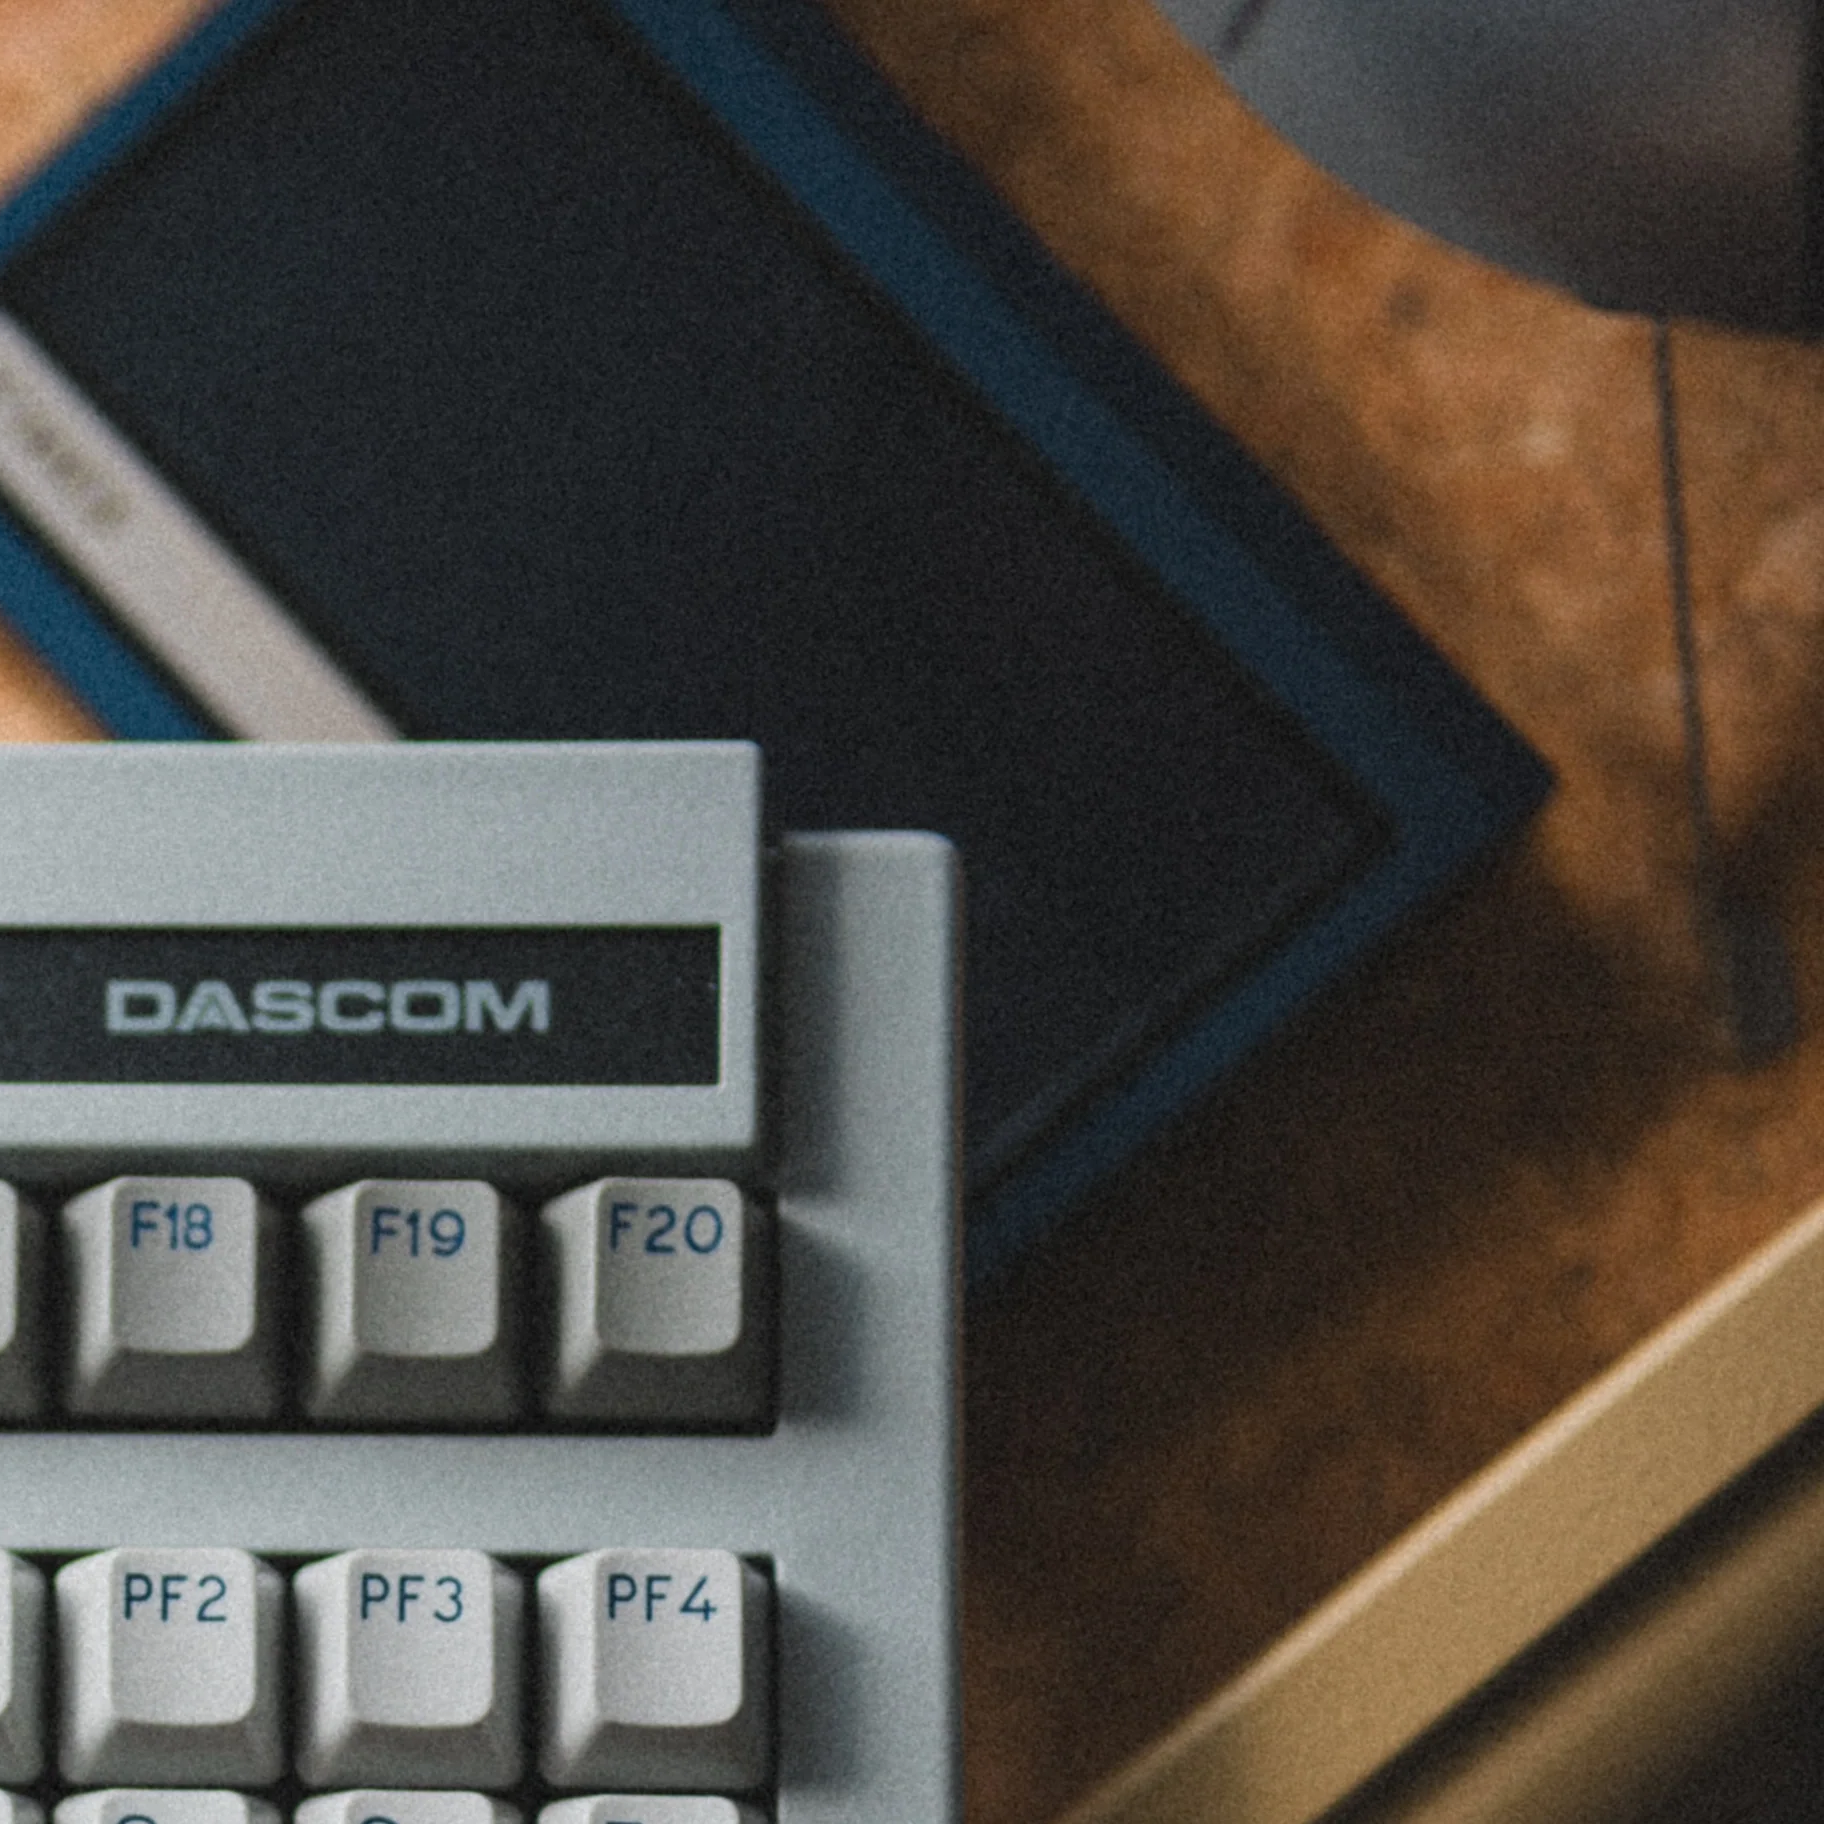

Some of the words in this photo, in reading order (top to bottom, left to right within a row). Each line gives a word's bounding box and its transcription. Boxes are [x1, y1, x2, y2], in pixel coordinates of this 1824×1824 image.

[104, 979, 550, 1034] DASCOM
[127, 1198, 214, 1252] F18
[367, 1203, 467, 1259] F19
[608, 1202, 726, 1255] F20
[121, 1570, 228, 1624] PF2
[357, 1570, 464, 1625] PF3
[604, 1570, 717, 1624] PF4
